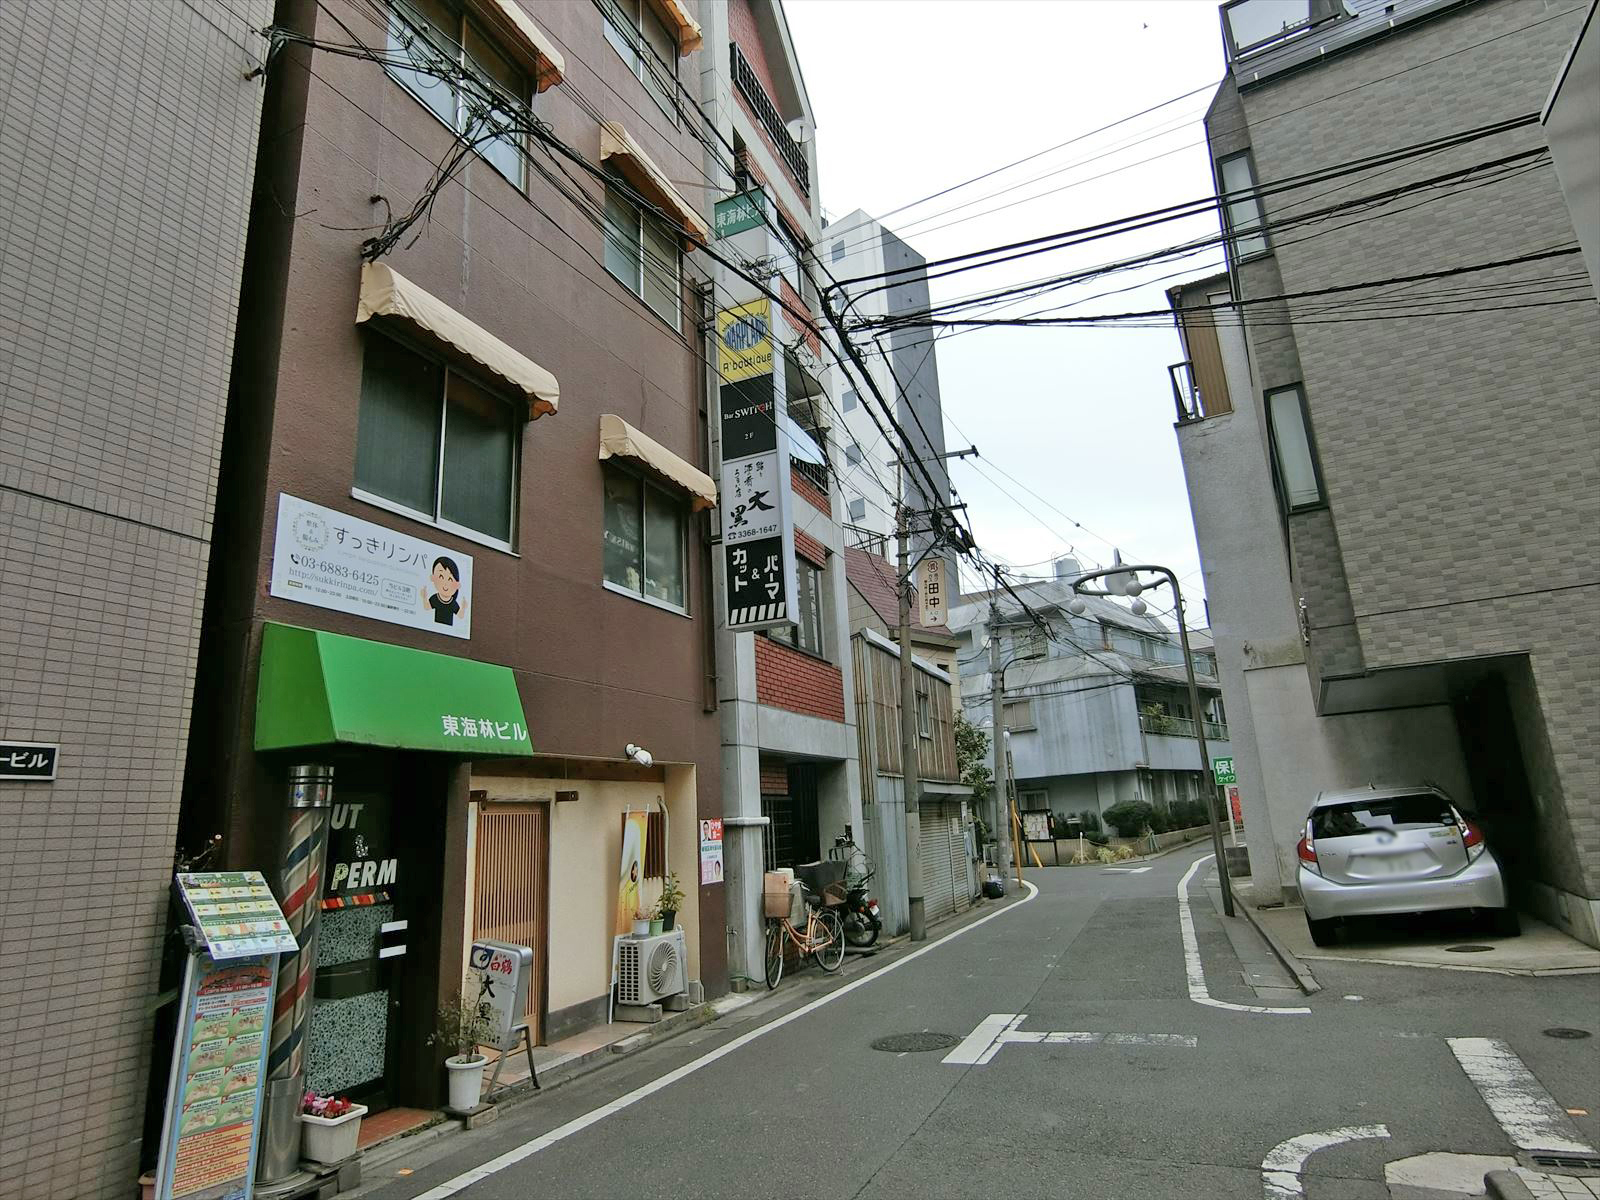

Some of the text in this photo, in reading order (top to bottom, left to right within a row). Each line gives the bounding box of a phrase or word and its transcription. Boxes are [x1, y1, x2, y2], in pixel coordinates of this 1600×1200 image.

[738, 525, 777, 539] 3368-1647
[300, 554, 380, 586] 03-6883-6425
[732, 548, 780, 600] カット & パーマ
[928, 582, 940, 608] 田中
[441, 714, 527, 742] 東海林ビル
[331, 803, 365, 830] UT
[331, 858, 398, 891] PERM
